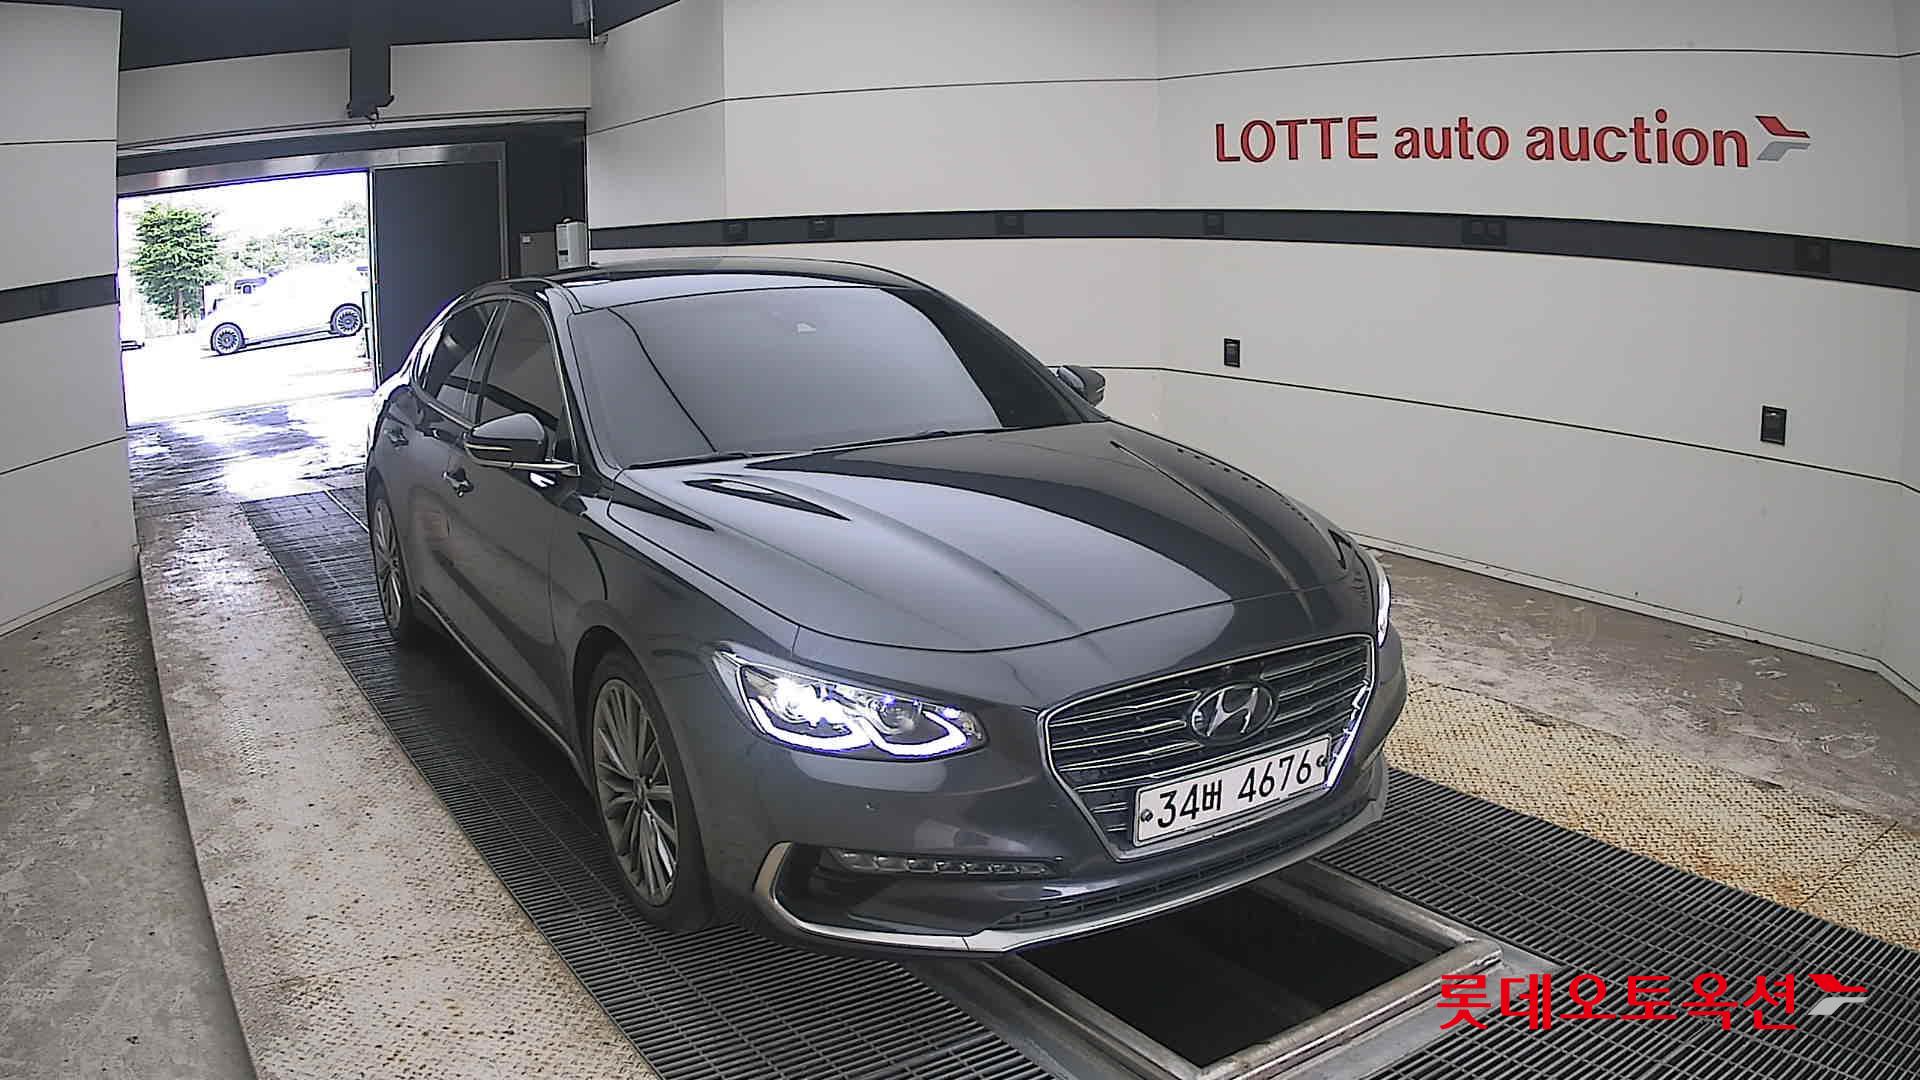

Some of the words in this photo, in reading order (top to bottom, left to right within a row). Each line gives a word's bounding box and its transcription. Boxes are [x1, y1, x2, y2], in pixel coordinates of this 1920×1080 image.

[1214, 115, 1378, 163] LOTTE
[1393, 116, 1510, 161] auto
[1525, 109, 1750, 168] auction
[1157, 779, 1223, 828] 34버
[1237, 749, 1312, 803] 4676
